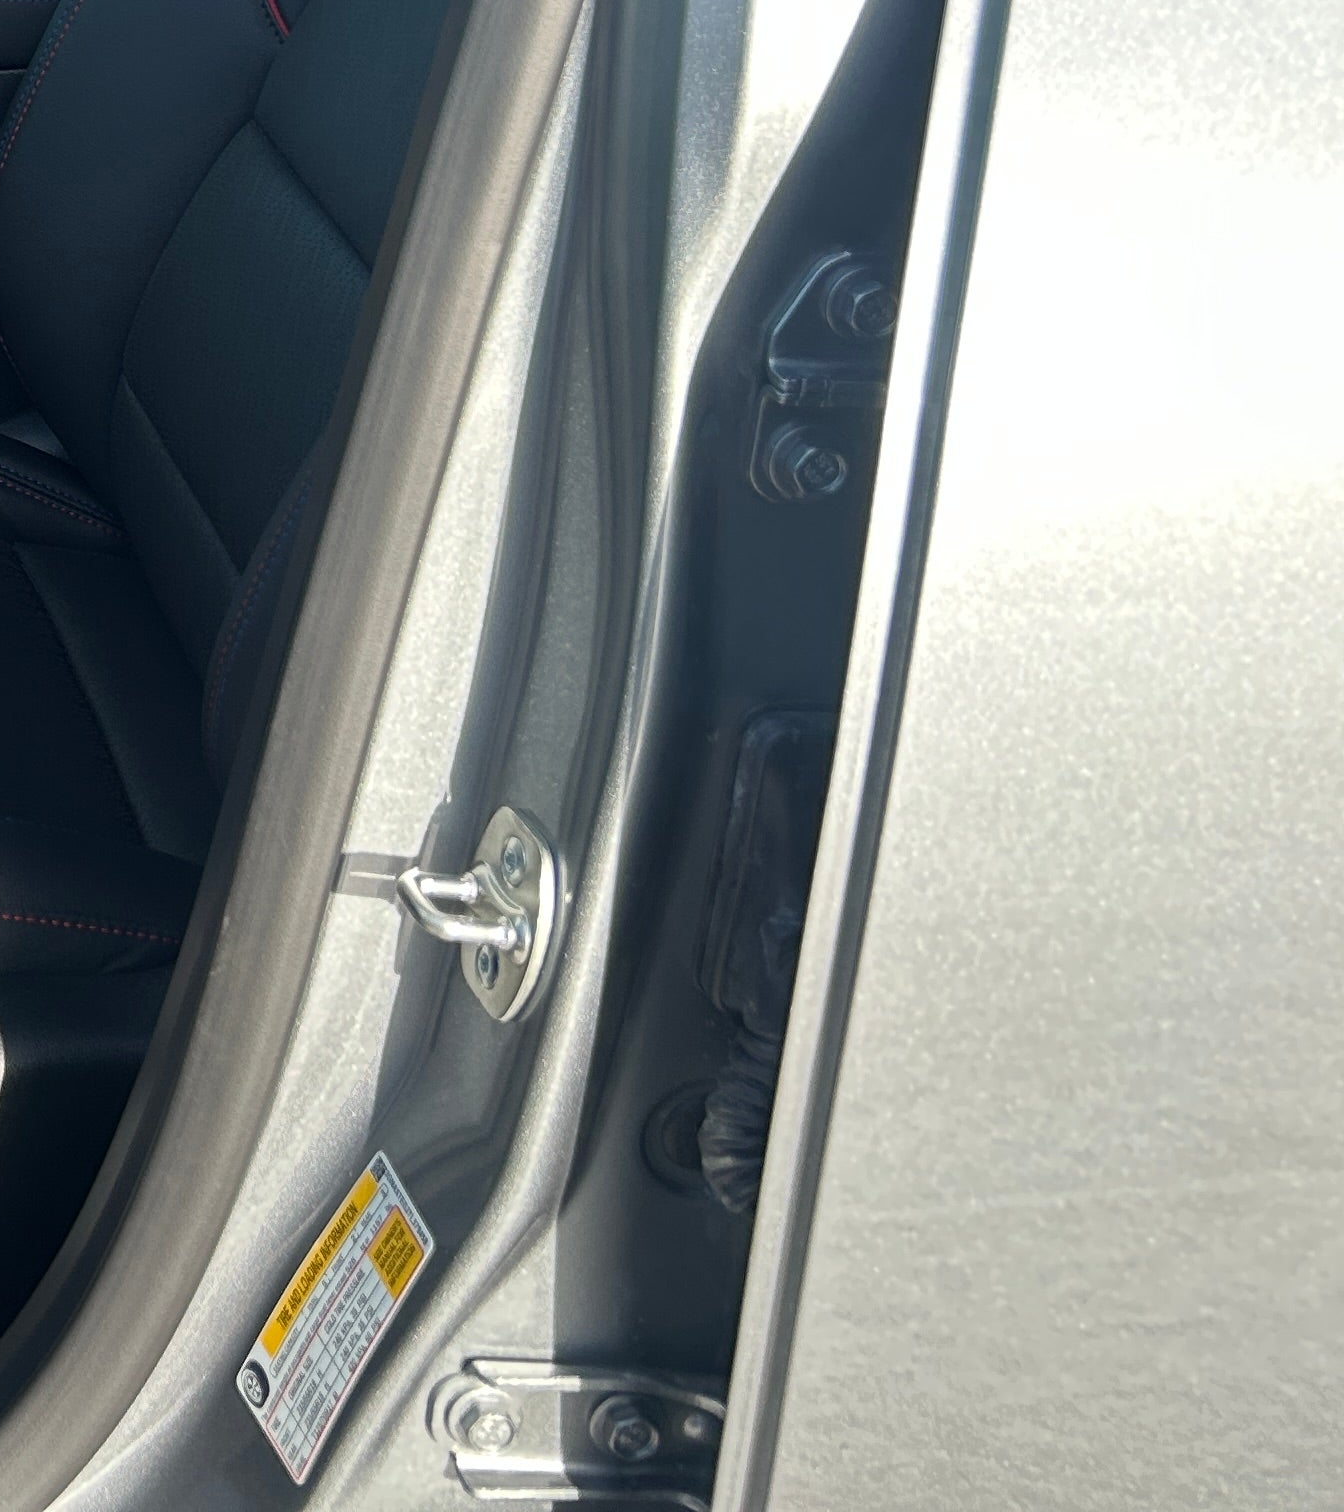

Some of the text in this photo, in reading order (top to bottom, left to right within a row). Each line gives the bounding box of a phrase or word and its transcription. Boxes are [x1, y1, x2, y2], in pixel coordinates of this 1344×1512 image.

[277, 1198, 358, 1331] TIRE AND LOADING INFORMATION
